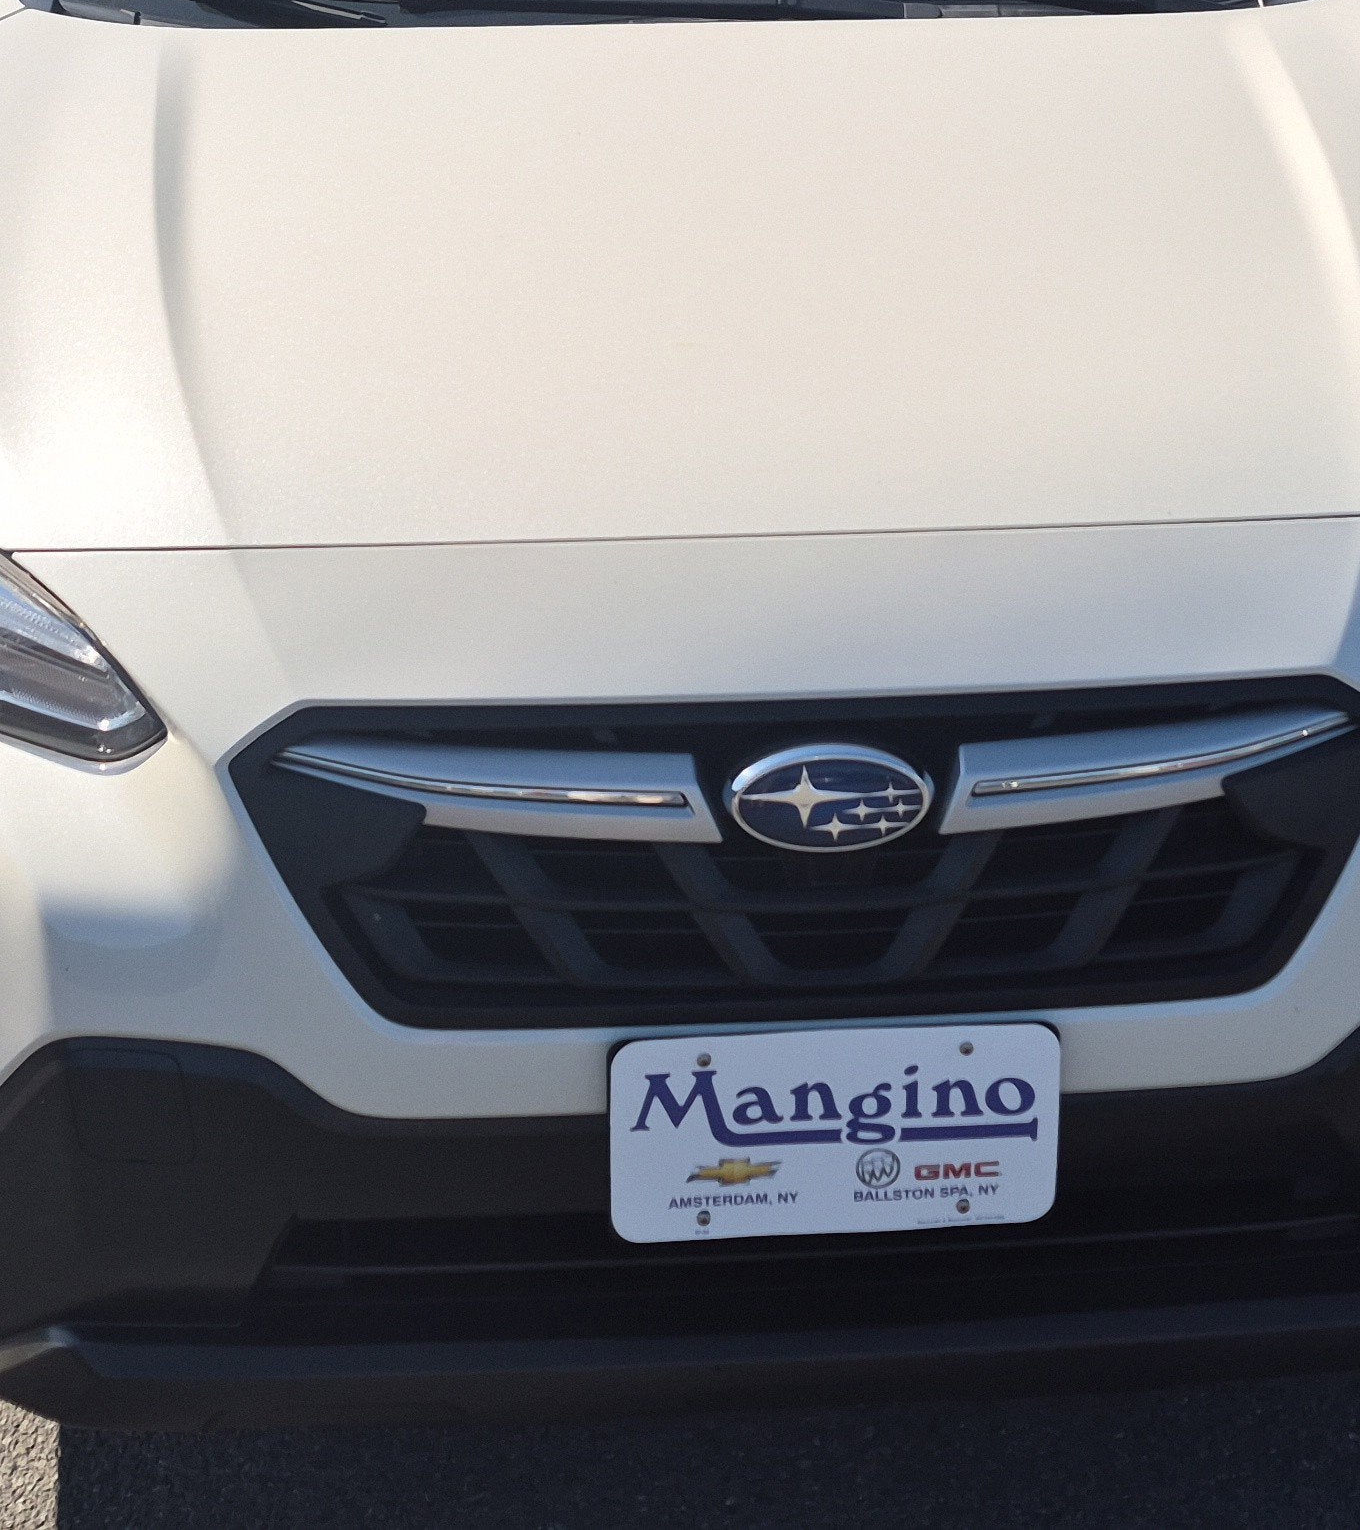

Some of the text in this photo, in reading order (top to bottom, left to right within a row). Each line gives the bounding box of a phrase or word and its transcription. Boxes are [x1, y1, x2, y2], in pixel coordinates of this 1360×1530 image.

[630, 1065, 1039, 1148] Mangino
[914, 1160, 1001, 1181] GMC
[668, 1191, 798, 1210] AMSTERDAM, NY
[853, 1184, 1000, 1202] BALLSTON SPA, NY
